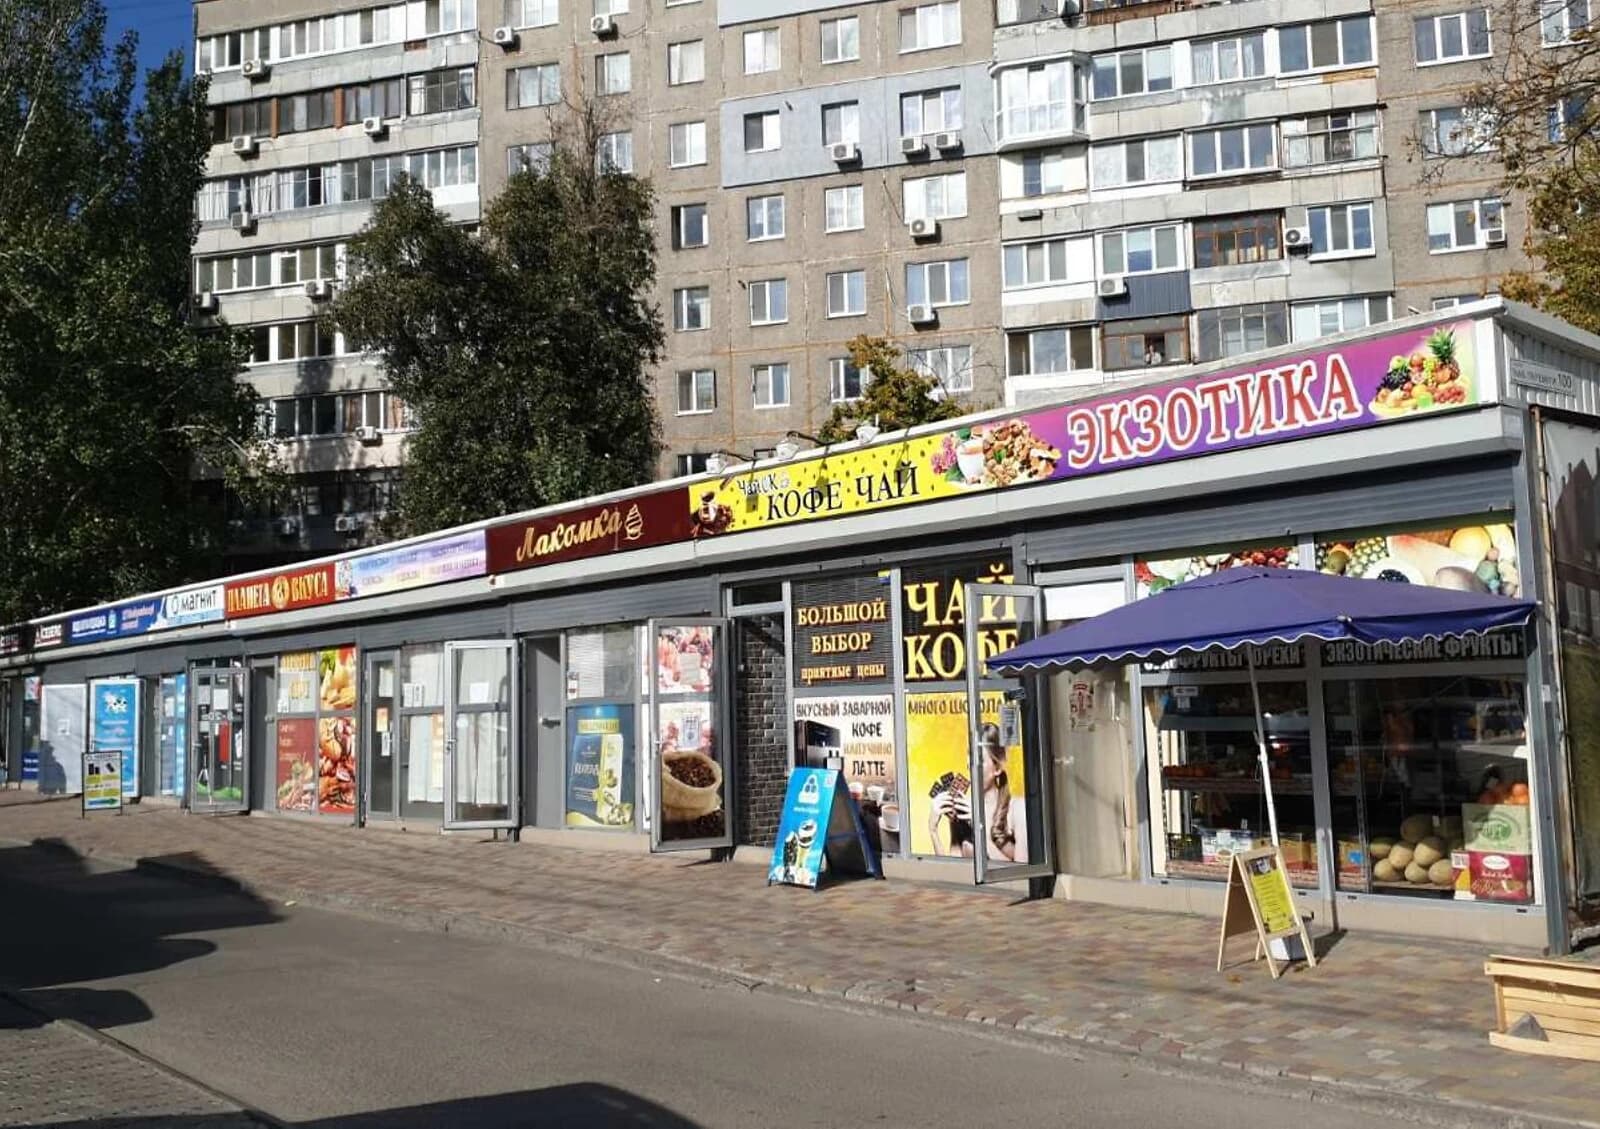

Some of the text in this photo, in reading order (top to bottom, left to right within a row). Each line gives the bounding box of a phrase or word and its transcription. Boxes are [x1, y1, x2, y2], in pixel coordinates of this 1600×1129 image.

[1066, 352, 1363, 470] ЭКЗОТИКА
[766, 462, 919, 520] КОФЕ ЧАЙ
[516, 507, 622, 562] Лакомка
[227, 571, 328, 612] ПЛАНЕТА ВКУСА
[903, 563, 1017, 627] ЧАЙ
[797, 597, 886, 625] БОЛЬШОЙ
[811, 632, 872, 654] ВЫБОР
[1326, 633, 1518, 663] ЭКЗОТИЧЕСКИЕ ФРУКТЫ
[801, 664, 885, 685] приятные цены
[796, 698, 891, 717] ВКУСНЫЙ ЗАВАРНОЙ
[908, 698, 946, 715] МНОГО
[852, 722, 883, 738] КОФЕ
[852, 760, 886, 777] ЛАТТЕ
